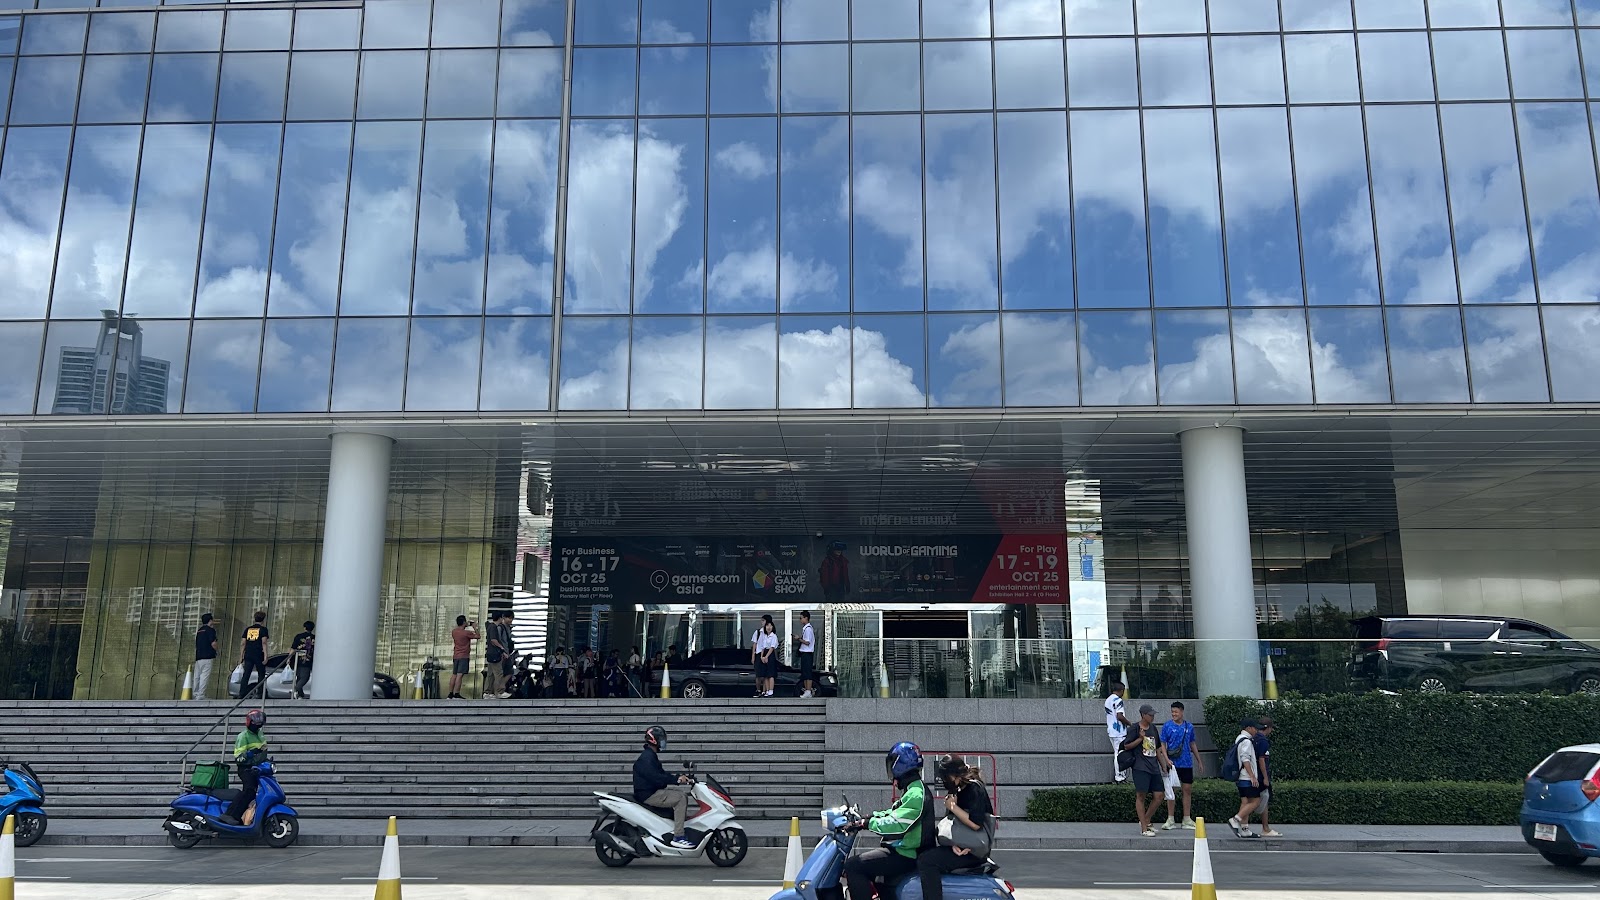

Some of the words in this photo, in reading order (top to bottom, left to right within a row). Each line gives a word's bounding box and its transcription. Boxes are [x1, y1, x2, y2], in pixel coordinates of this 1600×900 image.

[860, 546, 902, 556] WORLD
[911, 546, 957, 556] GAMING
[1037, 545, 1057, 554] Play
[561, 557, 582, 571] 16
[600, 557, 620, 571] 17
[997, 555, 1018, 570] 17
[1036, 555, 1058, 570] 19
[560, 573, 587, 583] OCT
[591, 573, 606, 583] 25
[672, 574, 740, 584] gamescom
[774, 576, 805, 584] GAME
[1012, 572, 1039, 582] OCT
[1043, 572, 1058, 581] 25
[676, 584, 704, 594] asia
[775, 585, 806, 594] SHOW
